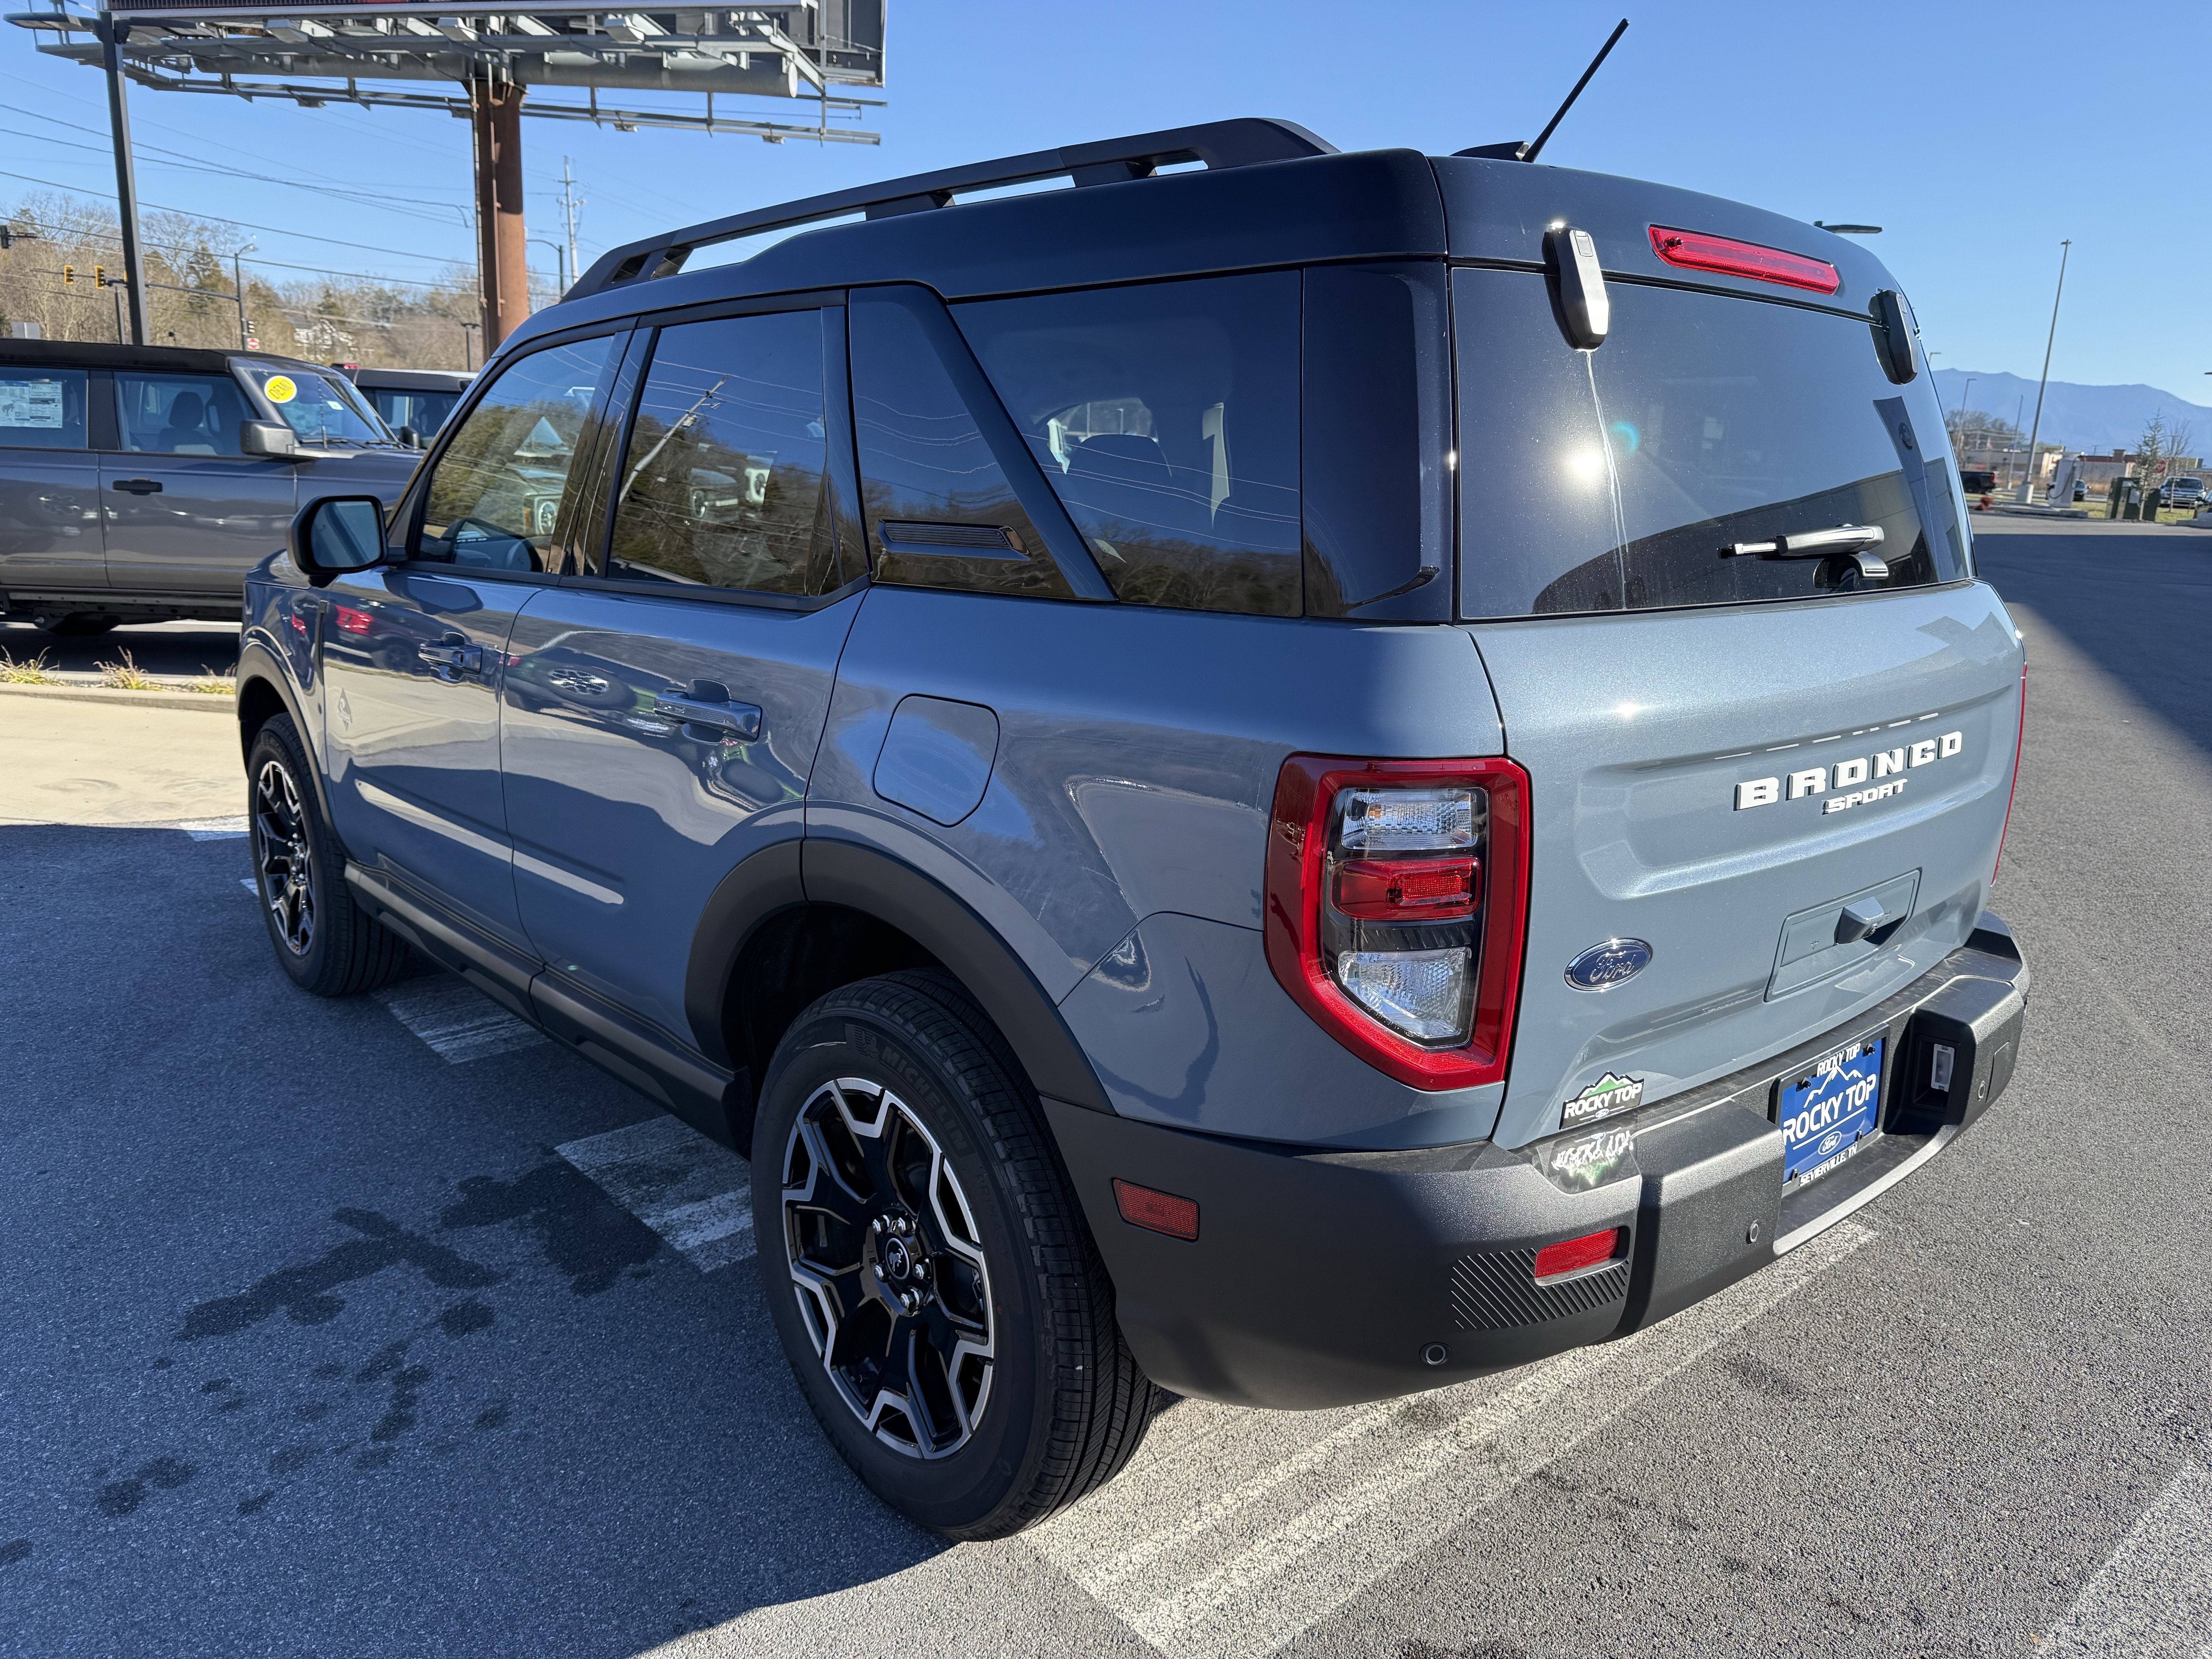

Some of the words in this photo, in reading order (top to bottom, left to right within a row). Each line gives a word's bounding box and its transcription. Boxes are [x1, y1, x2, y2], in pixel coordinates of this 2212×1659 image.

[268, 380, 292, 399] DEMO
[1733, 731, 1962, 811] BRONCO
[1822, 778, 1908, 815] SPORT
[1590, 951, 1636, 982] Ford
[1817, 1051, 1844, 1077] ROCKY
[1846, 1042, 1861, 1062] TOP
[882, 1046, 968, 1150] MICHELIN
[1564, 1091, 1614, 1118] ROCKY
[1614, 1082, 1642, 1104] TOP
[1783, 1092, 1844, 1146] ROCKY
[1846, 1073, 1877, 1112] TOP
[1822, 1135, 1838, 1152] Ford
[1847, 1144, 1858, 1158] TN
